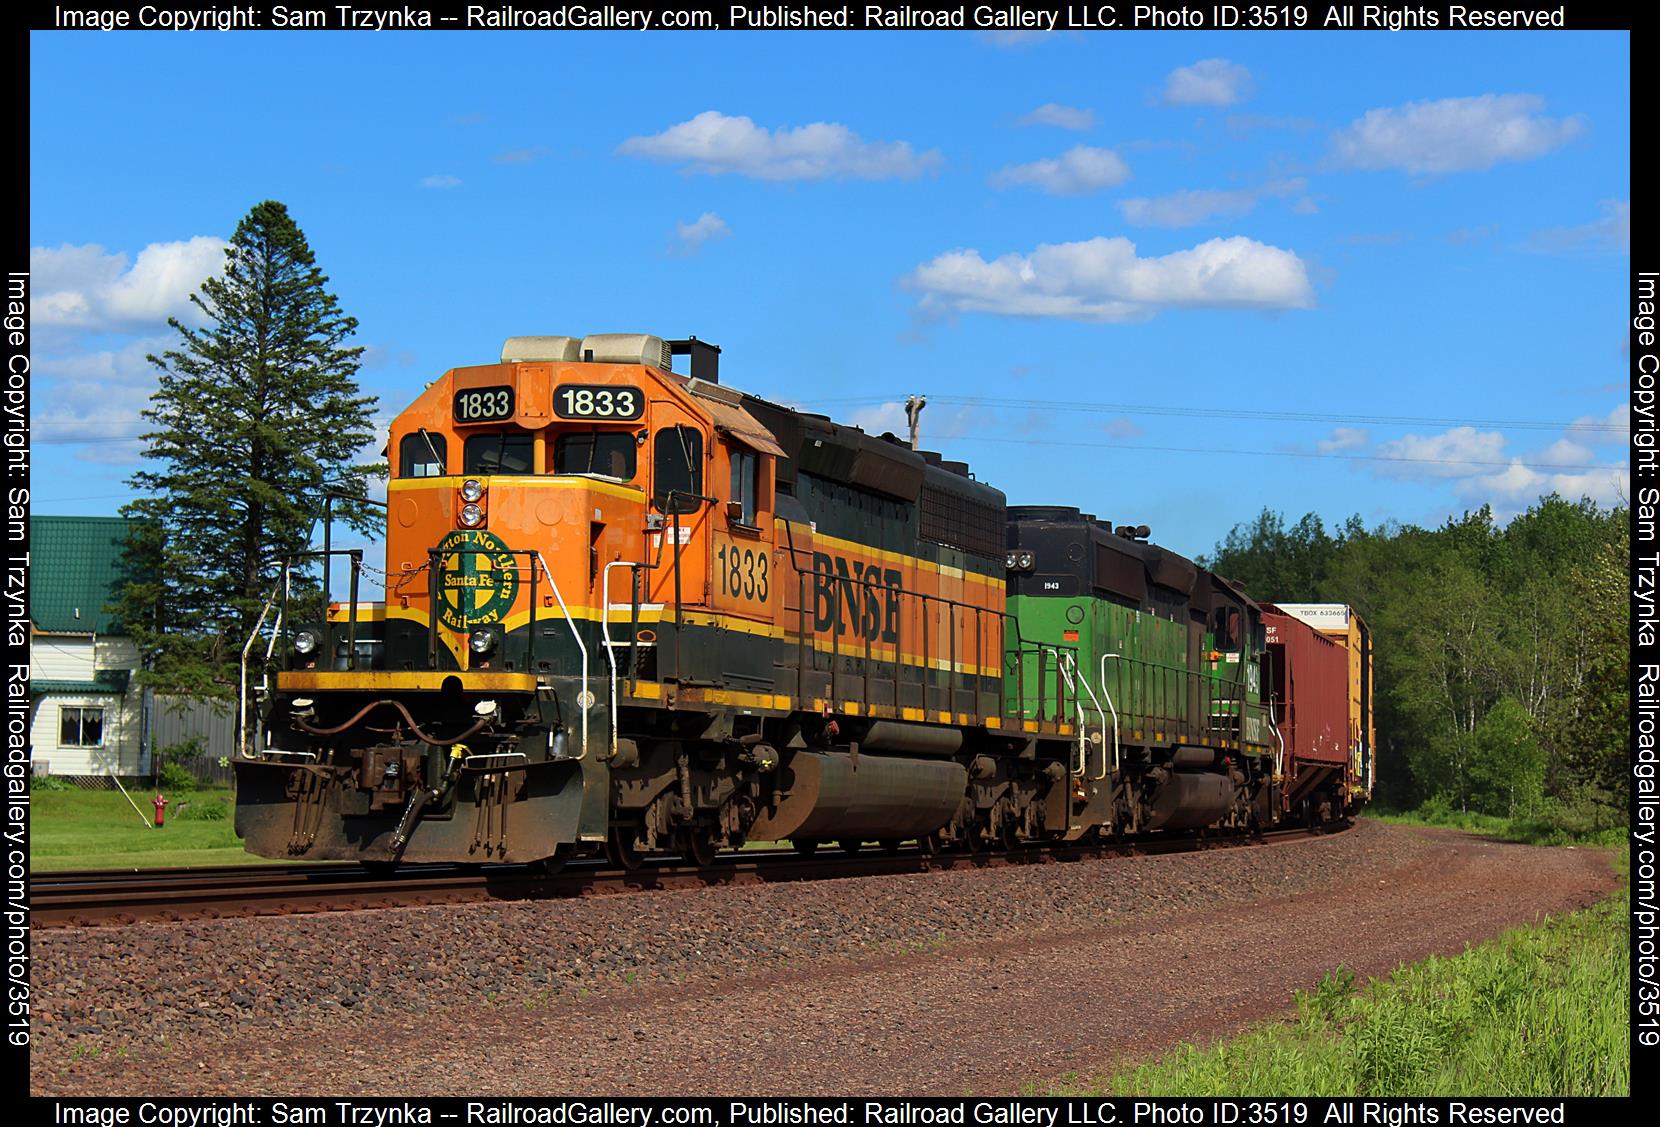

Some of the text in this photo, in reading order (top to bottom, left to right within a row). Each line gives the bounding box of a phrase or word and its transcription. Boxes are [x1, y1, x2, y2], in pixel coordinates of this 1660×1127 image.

[459, 391, 509, 418] 1833
[562, 389, 635, 416] 1833
[444, 573, 495, 587] Santa Fe
[718, 543, 768, 603] 1833
[1044, 582, 1059, 590] 1943
[813, 551, 902, 644] BNSF
